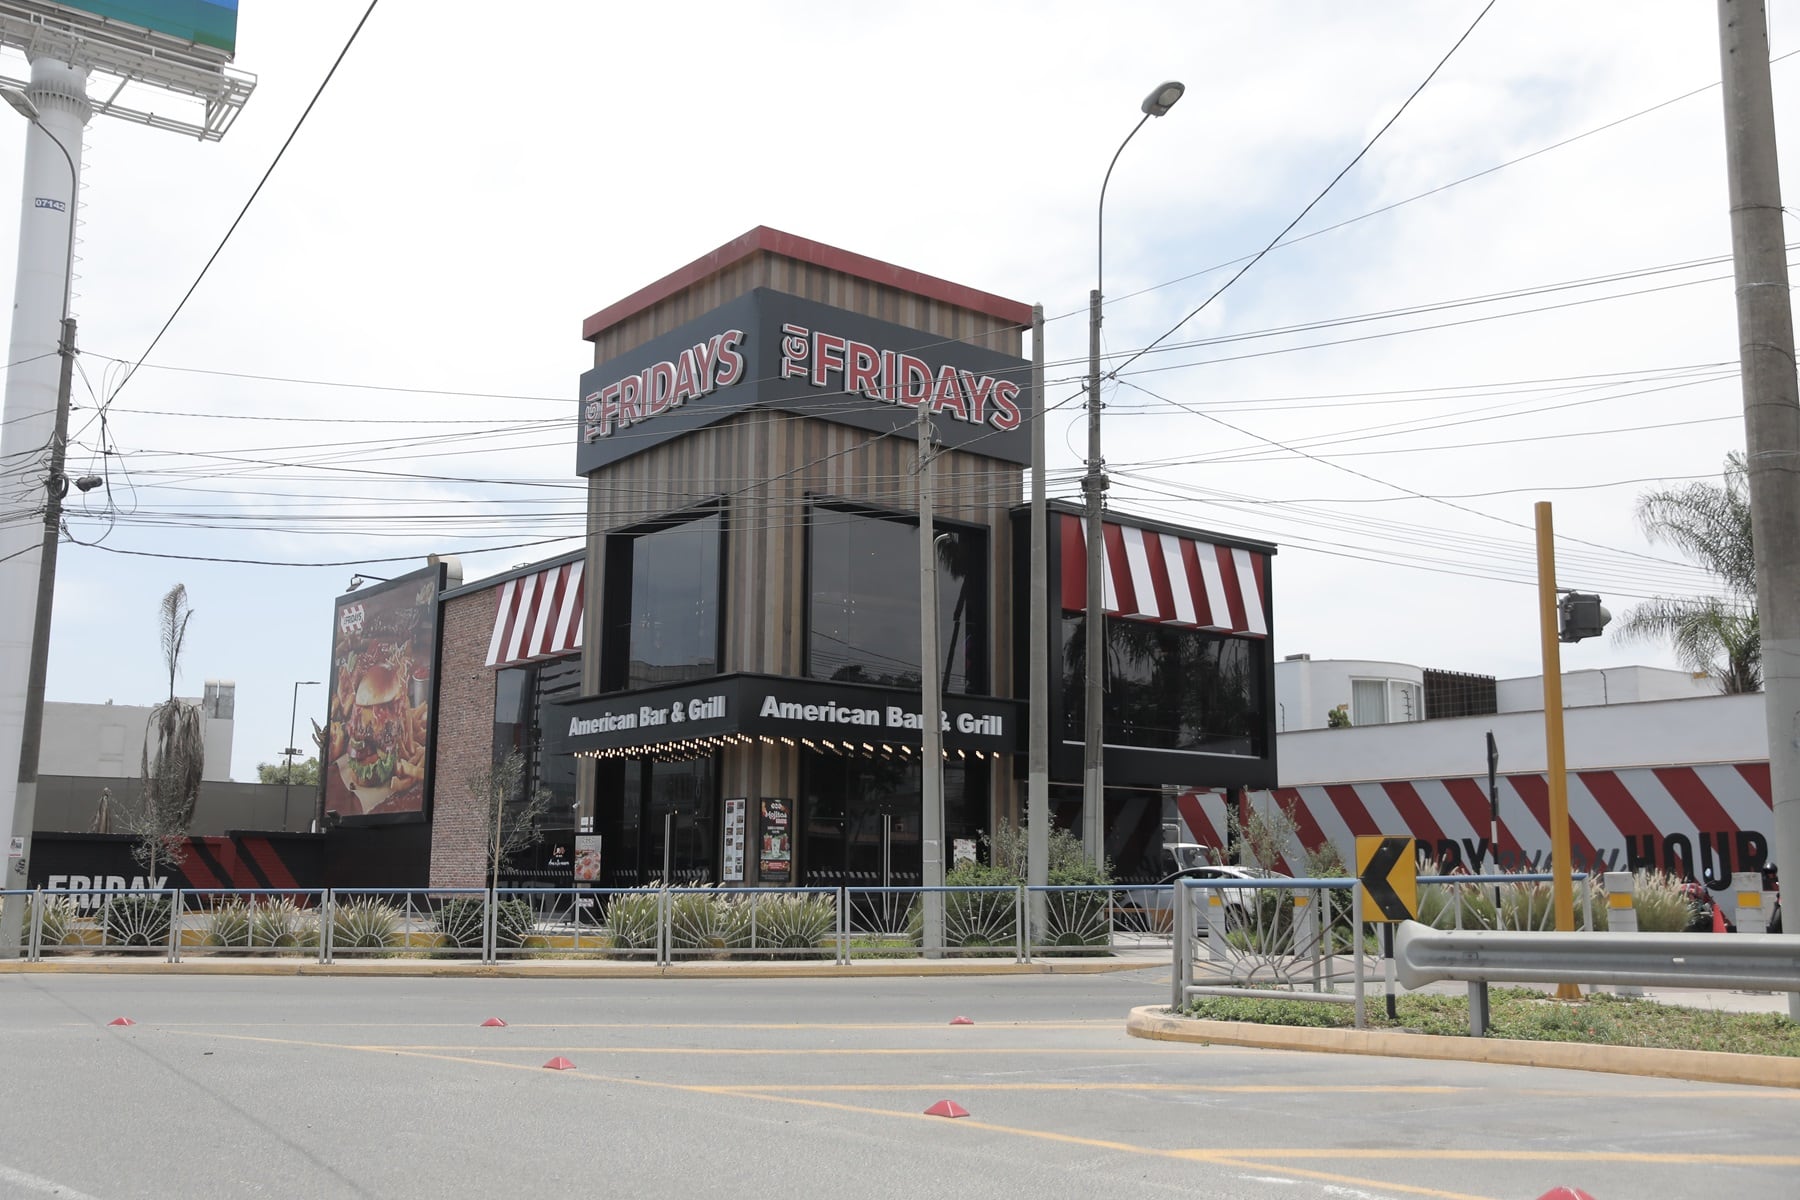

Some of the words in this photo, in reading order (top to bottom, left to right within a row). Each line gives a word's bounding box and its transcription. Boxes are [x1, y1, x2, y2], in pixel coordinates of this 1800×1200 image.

[600, 329, 744, 437] FRIDAYS
[781, 323, 809, 379] TGI
[811, 331, 1022, 431] FRIDAYS
[568, 711, 638, 737] American
[639, 706, 670, 727] Bar
[670, 701, 686, 723] &
[688, 695, 726, 721] Grill
[759, 695, 880, 726] American
[956, 713, 1003, 736] Grill
[1626, 831, 1779, 891] HOUR
[47, 875, 168, 908] FRIDAY
